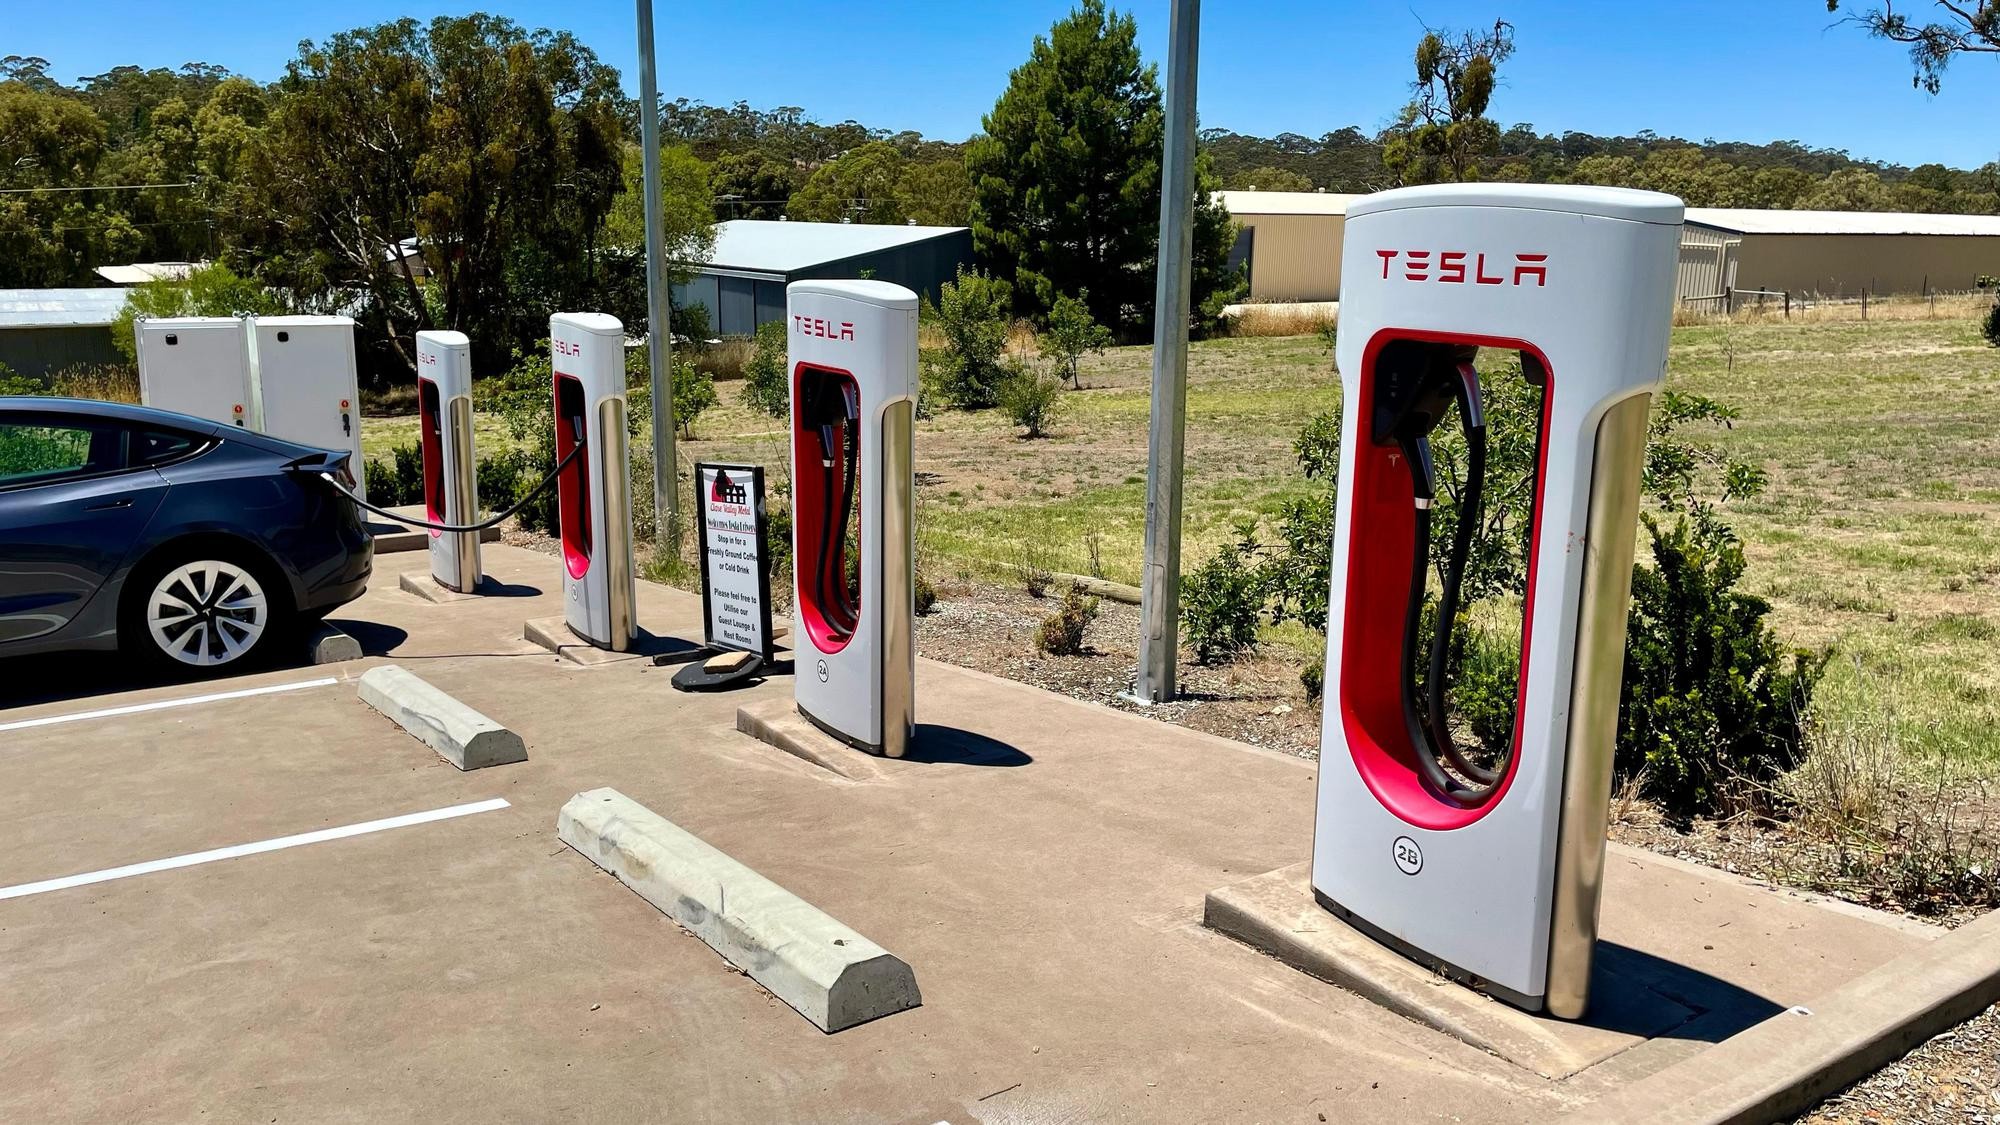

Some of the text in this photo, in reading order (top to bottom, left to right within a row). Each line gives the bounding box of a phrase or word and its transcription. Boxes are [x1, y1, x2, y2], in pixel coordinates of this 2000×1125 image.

[1376, 250, 1549, 287] TESLA
[794, 315, 854, 341] TESLA
[555, 340, 580, 357] ESLA
[723, 504, 737, 516] Valley
[738, 505, 751, 515] Motel
[718, 534, 728, 545] Stop
[730, 536, 734, 544] in
[725, 549, 742, 560] Ground
[725, 563, 735, 572] Cold
[737, 565, 749, 574] Drink
[714, 588, 729, 598] Please
[730, 591, 739, 600] feel
[740, 593, 750, 603] free
[724, 603, 739, 614] Utilise
[718, 615, 756, 631] Guest Lounge &
[724, 630, 751, 644] Rest Rooms
[1397, 845, 1418, 865] 2B
